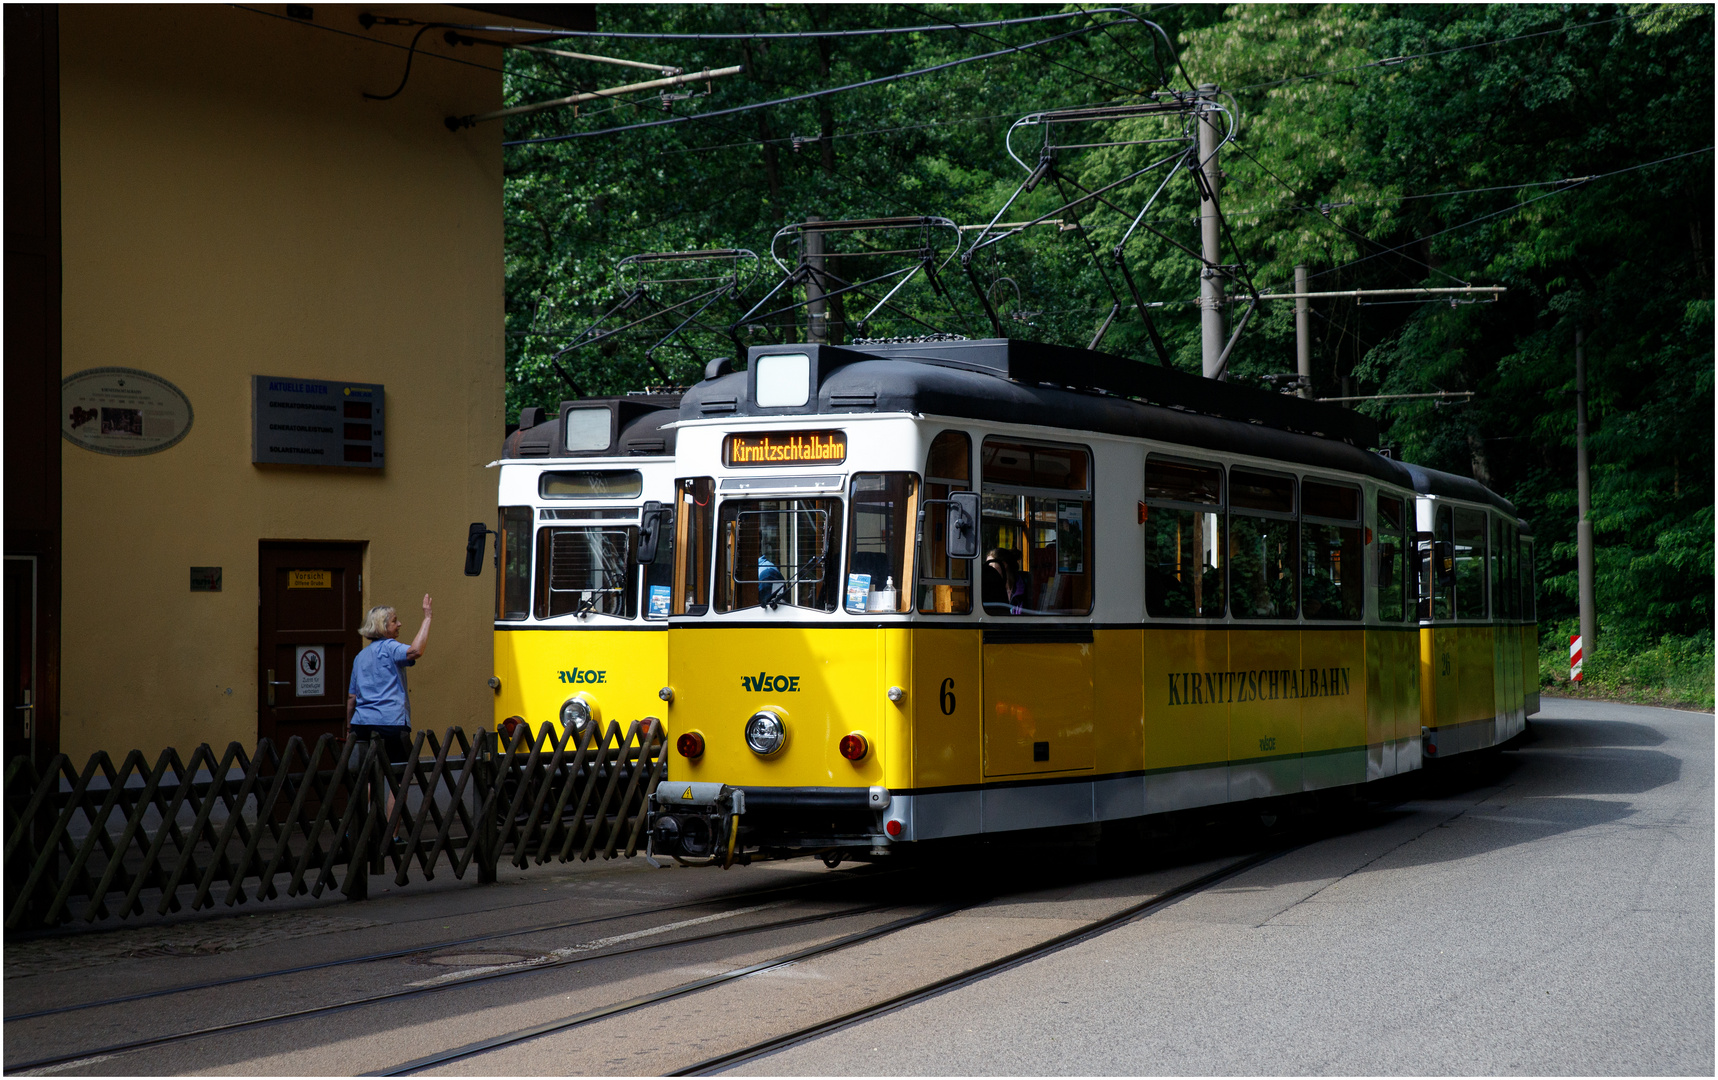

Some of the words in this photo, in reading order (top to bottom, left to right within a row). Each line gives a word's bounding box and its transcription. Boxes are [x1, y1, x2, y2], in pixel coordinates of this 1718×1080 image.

[269, 381, 303, 392] AKTUELLE
[305, 384, 328, 394] DATEN
[269, 401, 337, 411] GENERATORSPANNUNG
[269, 424, 334, 434] GENERATORLEISTUNG
[269, 446, 325, 455] SOLARSTRAHLUNG
[733, 435, 844, 462] Kirnitzschtalbahn
[295, 572, 324, 580] Vorsicht
[1441, 652, 1451, 676] 26
[1167, 667, 1350, 706] KIRNITZSCHTALBAHN
[939, 677, 956, 715] 6
